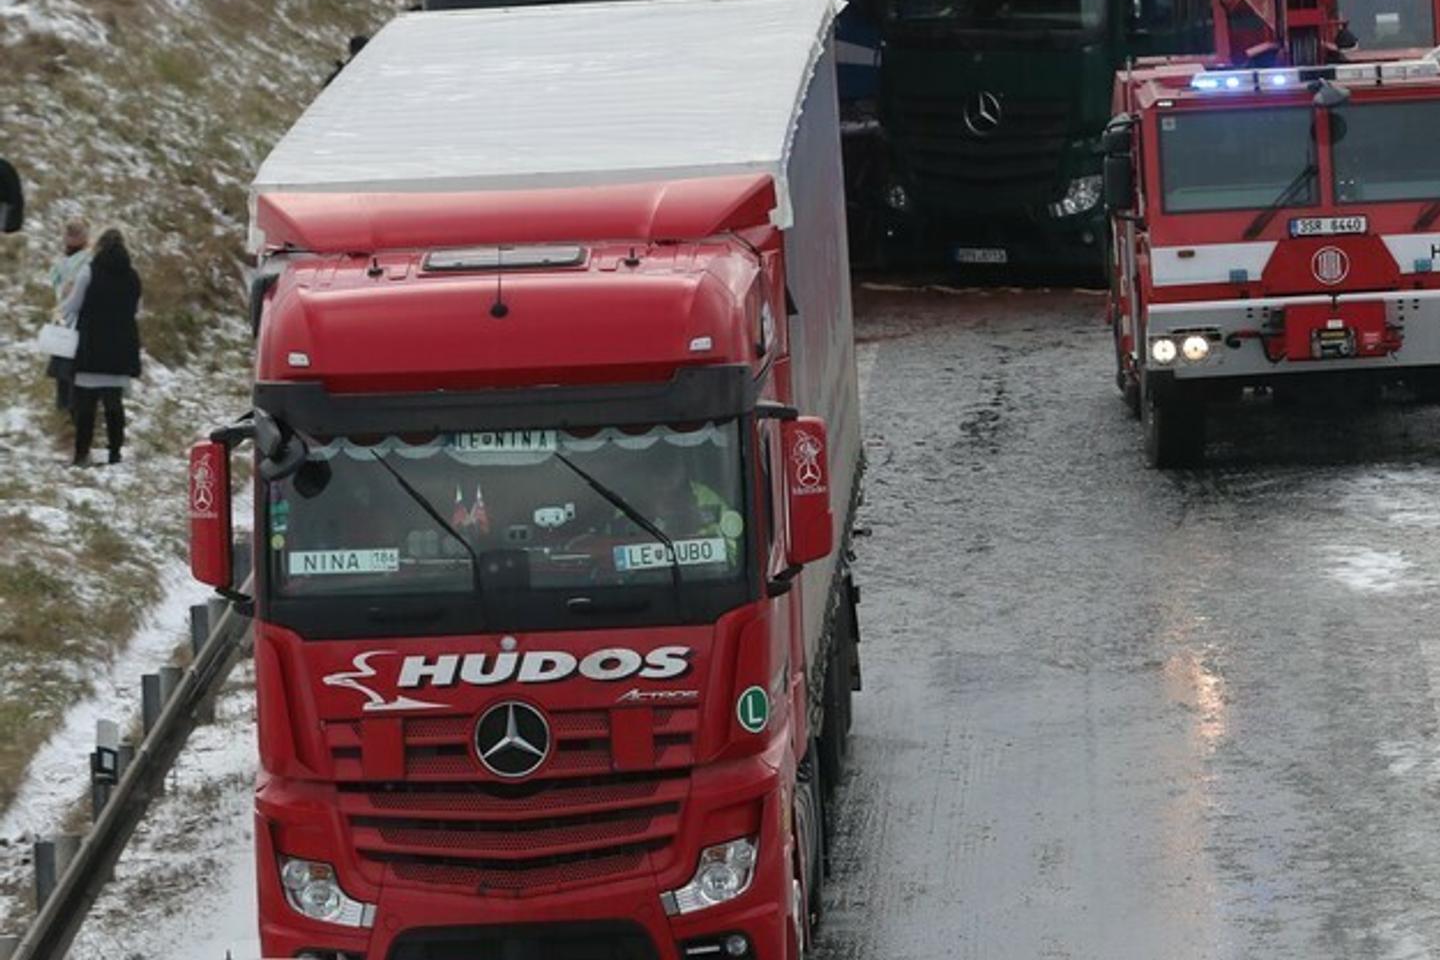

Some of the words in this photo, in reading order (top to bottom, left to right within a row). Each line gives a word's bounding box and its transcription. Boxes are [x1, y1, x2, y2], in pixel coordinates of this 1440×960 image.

[304, 553, 360, 571] NINA
[629, 546, 653, 566] LE
[397, 647, 691, 688] HUDOS
[747, 695, 764, 724] L
